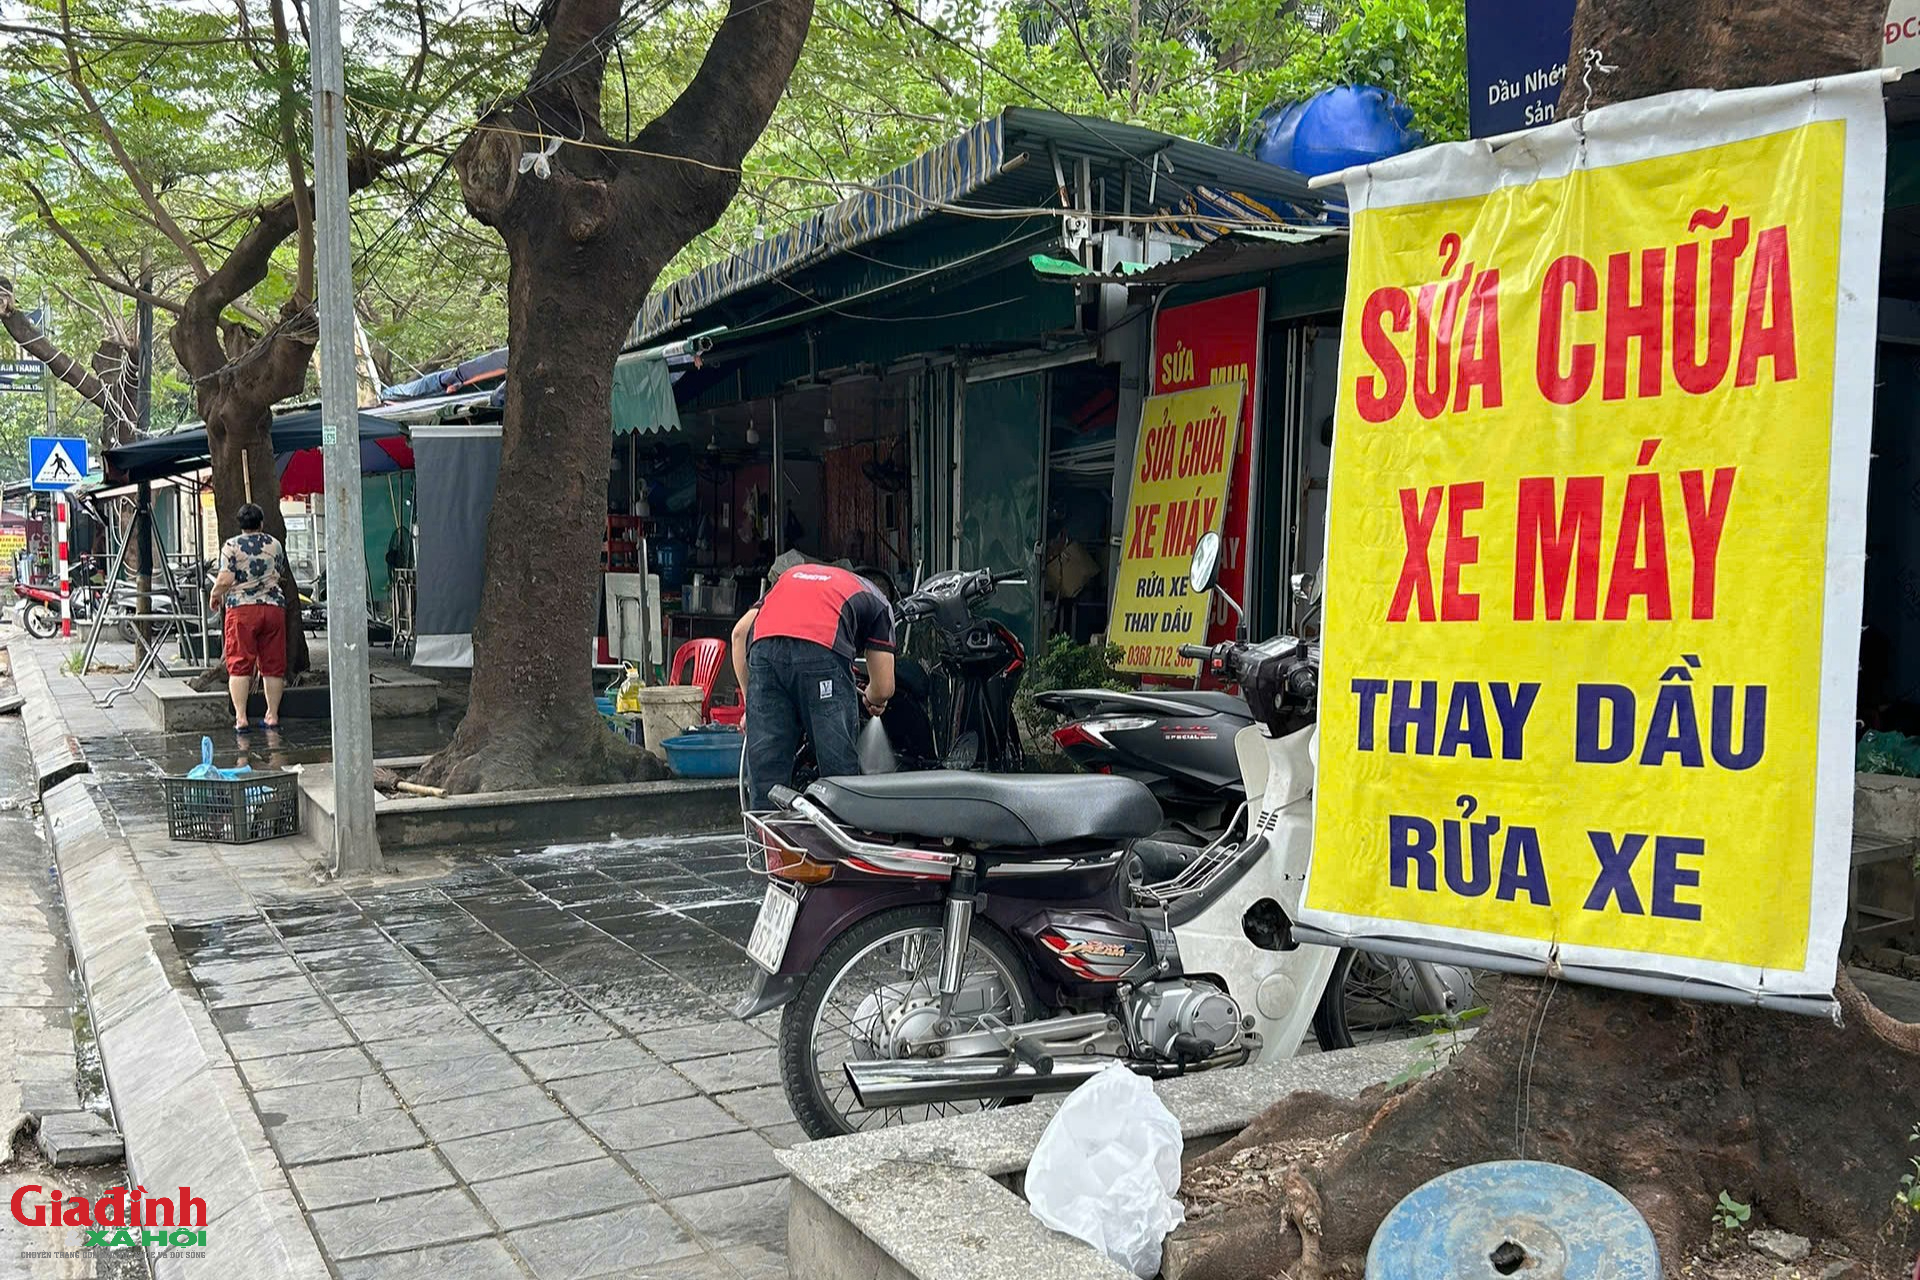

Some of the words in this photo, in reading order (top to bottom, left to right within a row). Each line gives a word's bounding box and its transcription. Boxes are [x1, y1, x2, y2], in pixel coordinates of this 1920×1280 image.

[1488, 78, 1520, 105] Dầu
[1525, 63, 1567, 95] Nhớt
[1525, 100, 1555, 126] Sản
[1356, 233, 1503, 424] SỬA
[1536, 205, 1798, 405] CHỮA
[1161, 341, 1195, 385] SỬA
[1141, 407, 1177, 483] SỬA
[1178, 405, 1227, 477] CHỮA
[1128, 504, 1161, 560] XE
[1161, 486, 1218, 558] MÁY
[1386, 481, 1484, 622] XE
[1513, 439, 1737, 622] MÁY
[1136, 571, 1165, 598] RỬA
[1168, 575, 1189, 597] XE
[1124, 611, 1159, 633] THAY
[1161, 603, 1193, 633] DẦU
[1127, 645, 1152, 667] 0368
[1154, 646, 1173, 667] 712
[1351, 679, 1542, 760] THAY
[1575, 655, 1768, 771] DẦU
[1388, 795, 1551, 907] RỬA
[1583, 831, 1705, 921] XE
